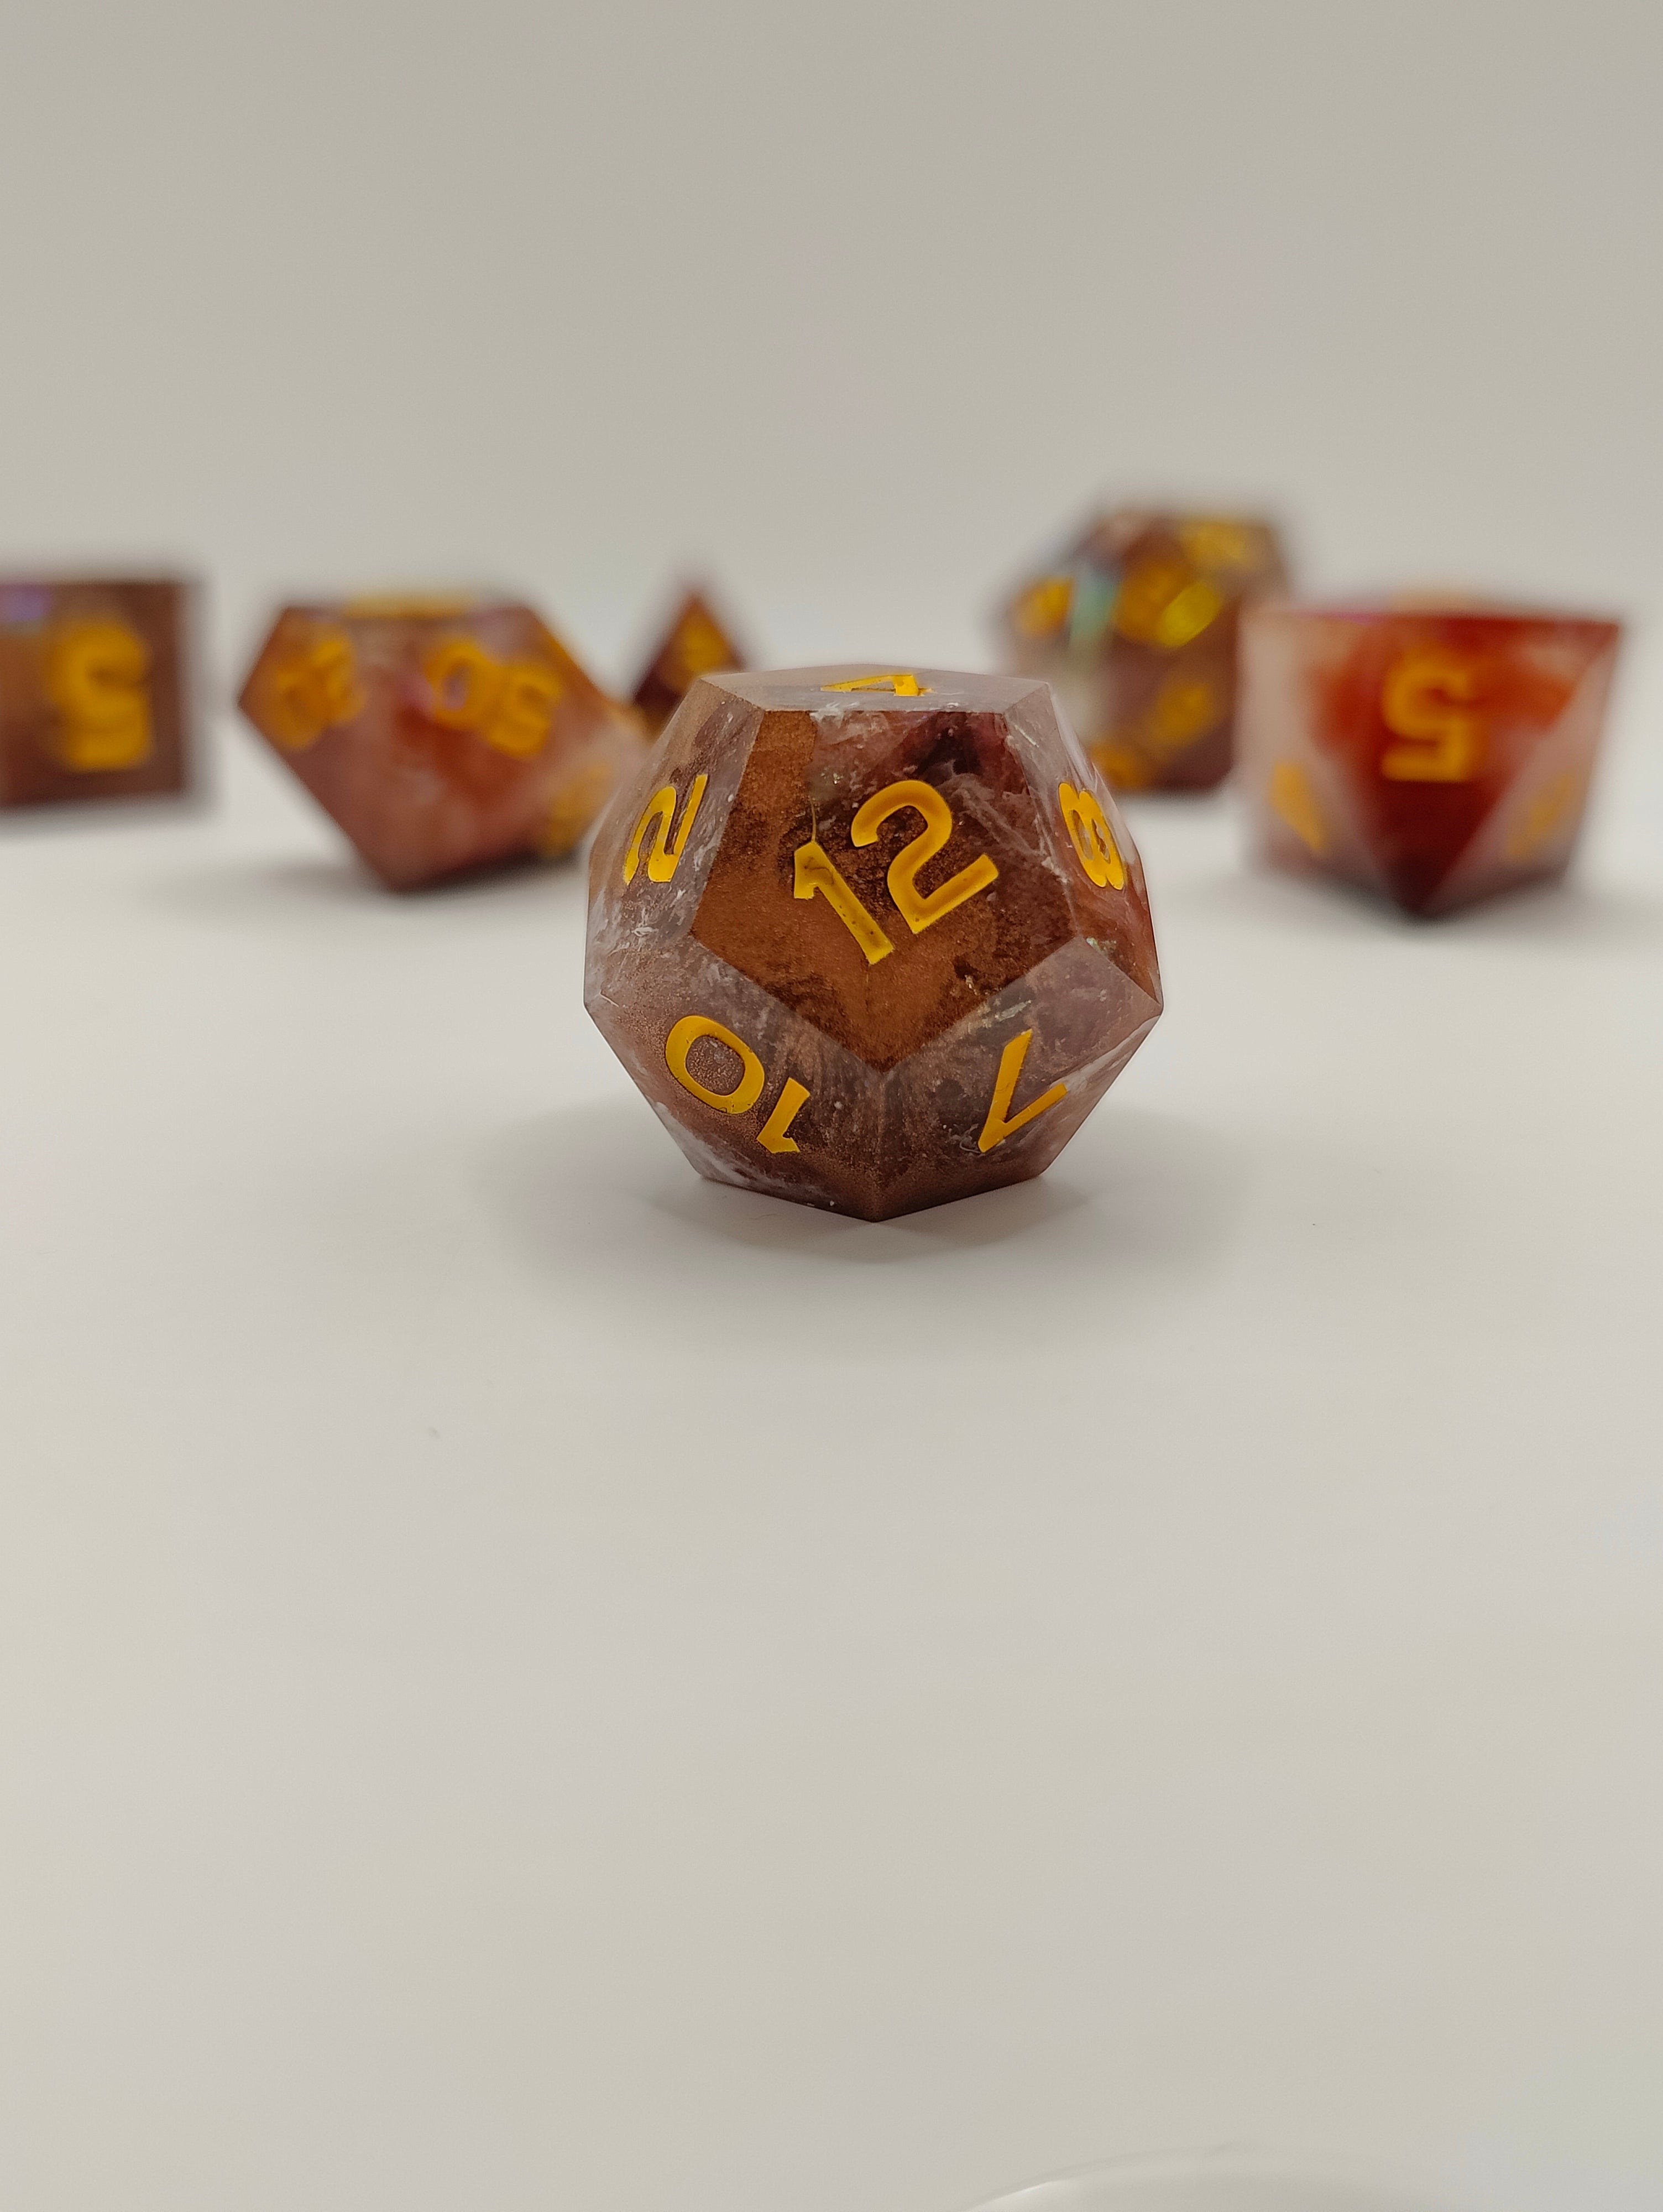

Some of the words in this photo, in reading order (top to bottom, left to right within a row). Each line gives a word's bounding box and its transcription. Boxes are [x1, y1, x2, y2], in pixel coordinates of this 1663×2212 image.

[1380, 657, 1472, 783] 5
[623, 774, 708, 885] 2
[794, 780, 999, 965] 12
[1058, 782, 1126, 890] 8
[665, 1015, 811, 1154] 10
